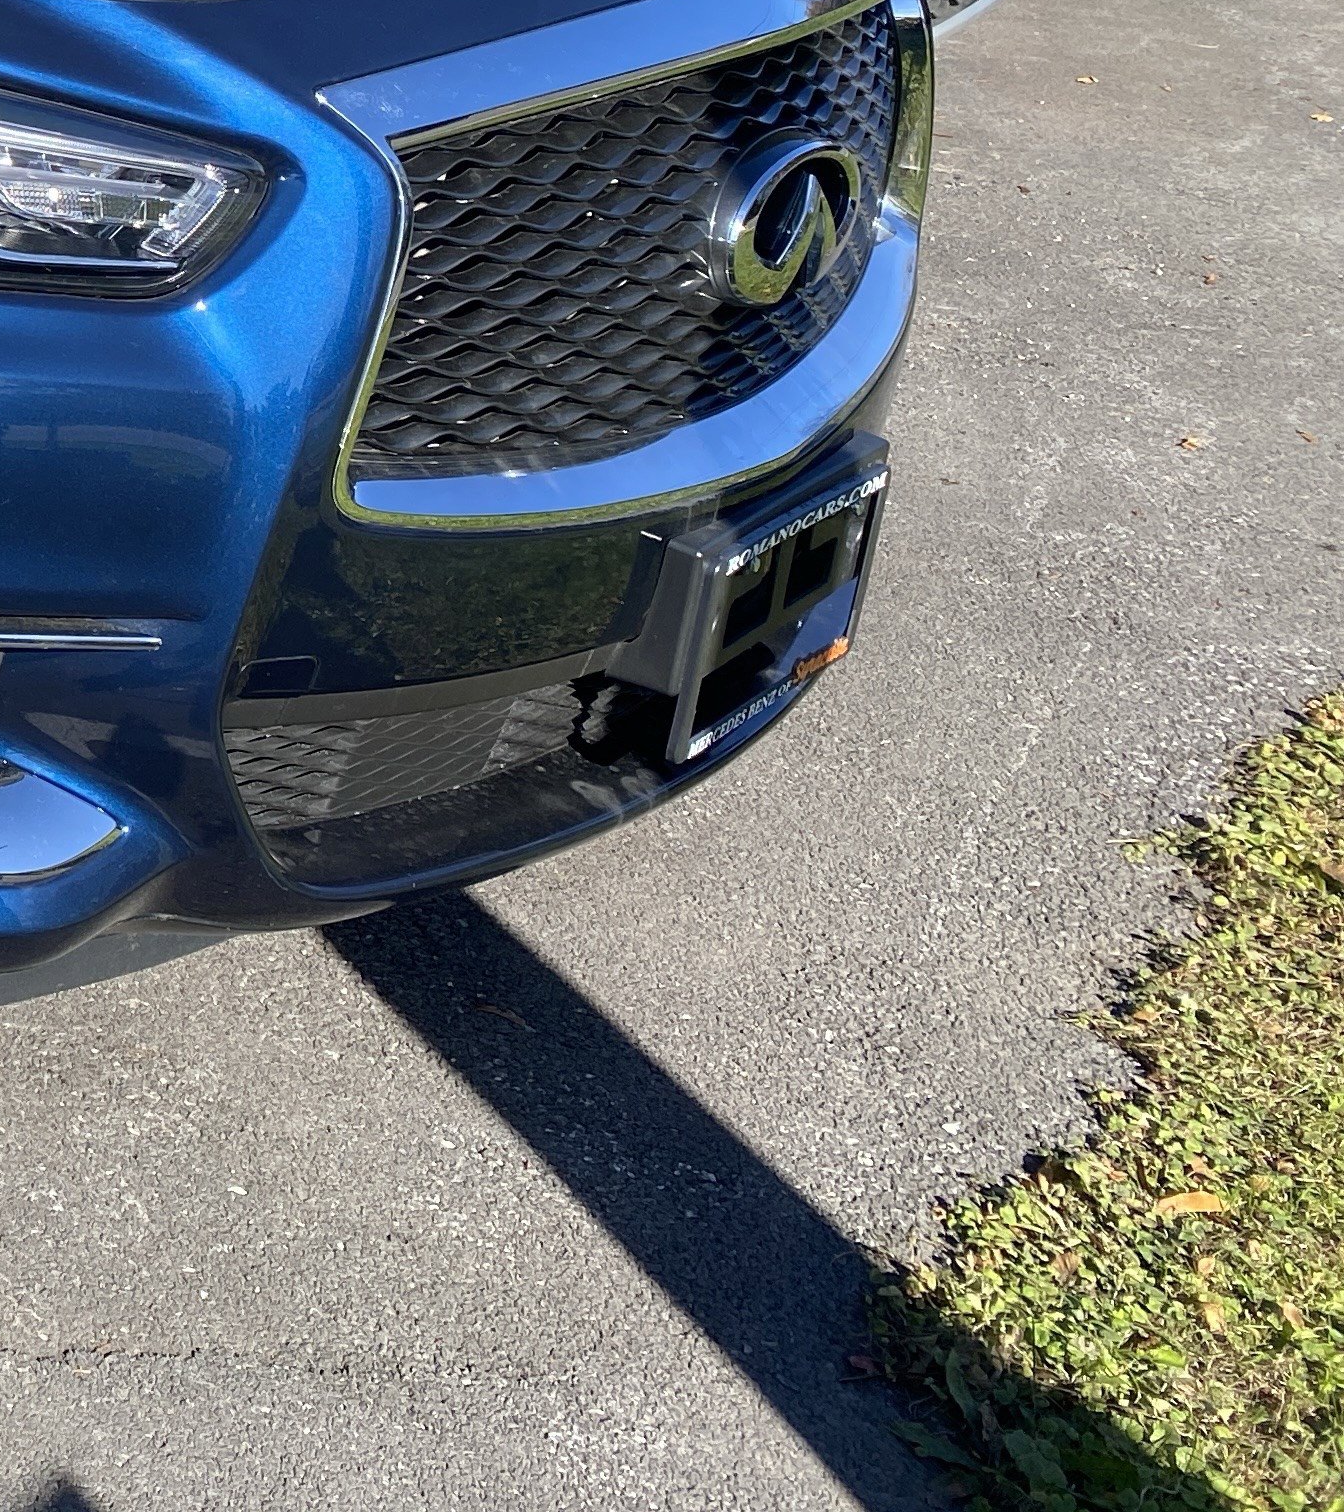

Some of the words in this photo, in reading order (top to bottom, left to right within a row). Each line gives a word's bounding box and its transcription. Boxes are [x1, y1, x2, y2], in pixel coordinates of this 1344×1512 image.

[724, 470, 889, 577] ROMANOCARS.COM
[686, 707, 748, 760] MERCEDES
[747, 689, 777, 720] BENZ
[776, 679, 794, 700] OF
